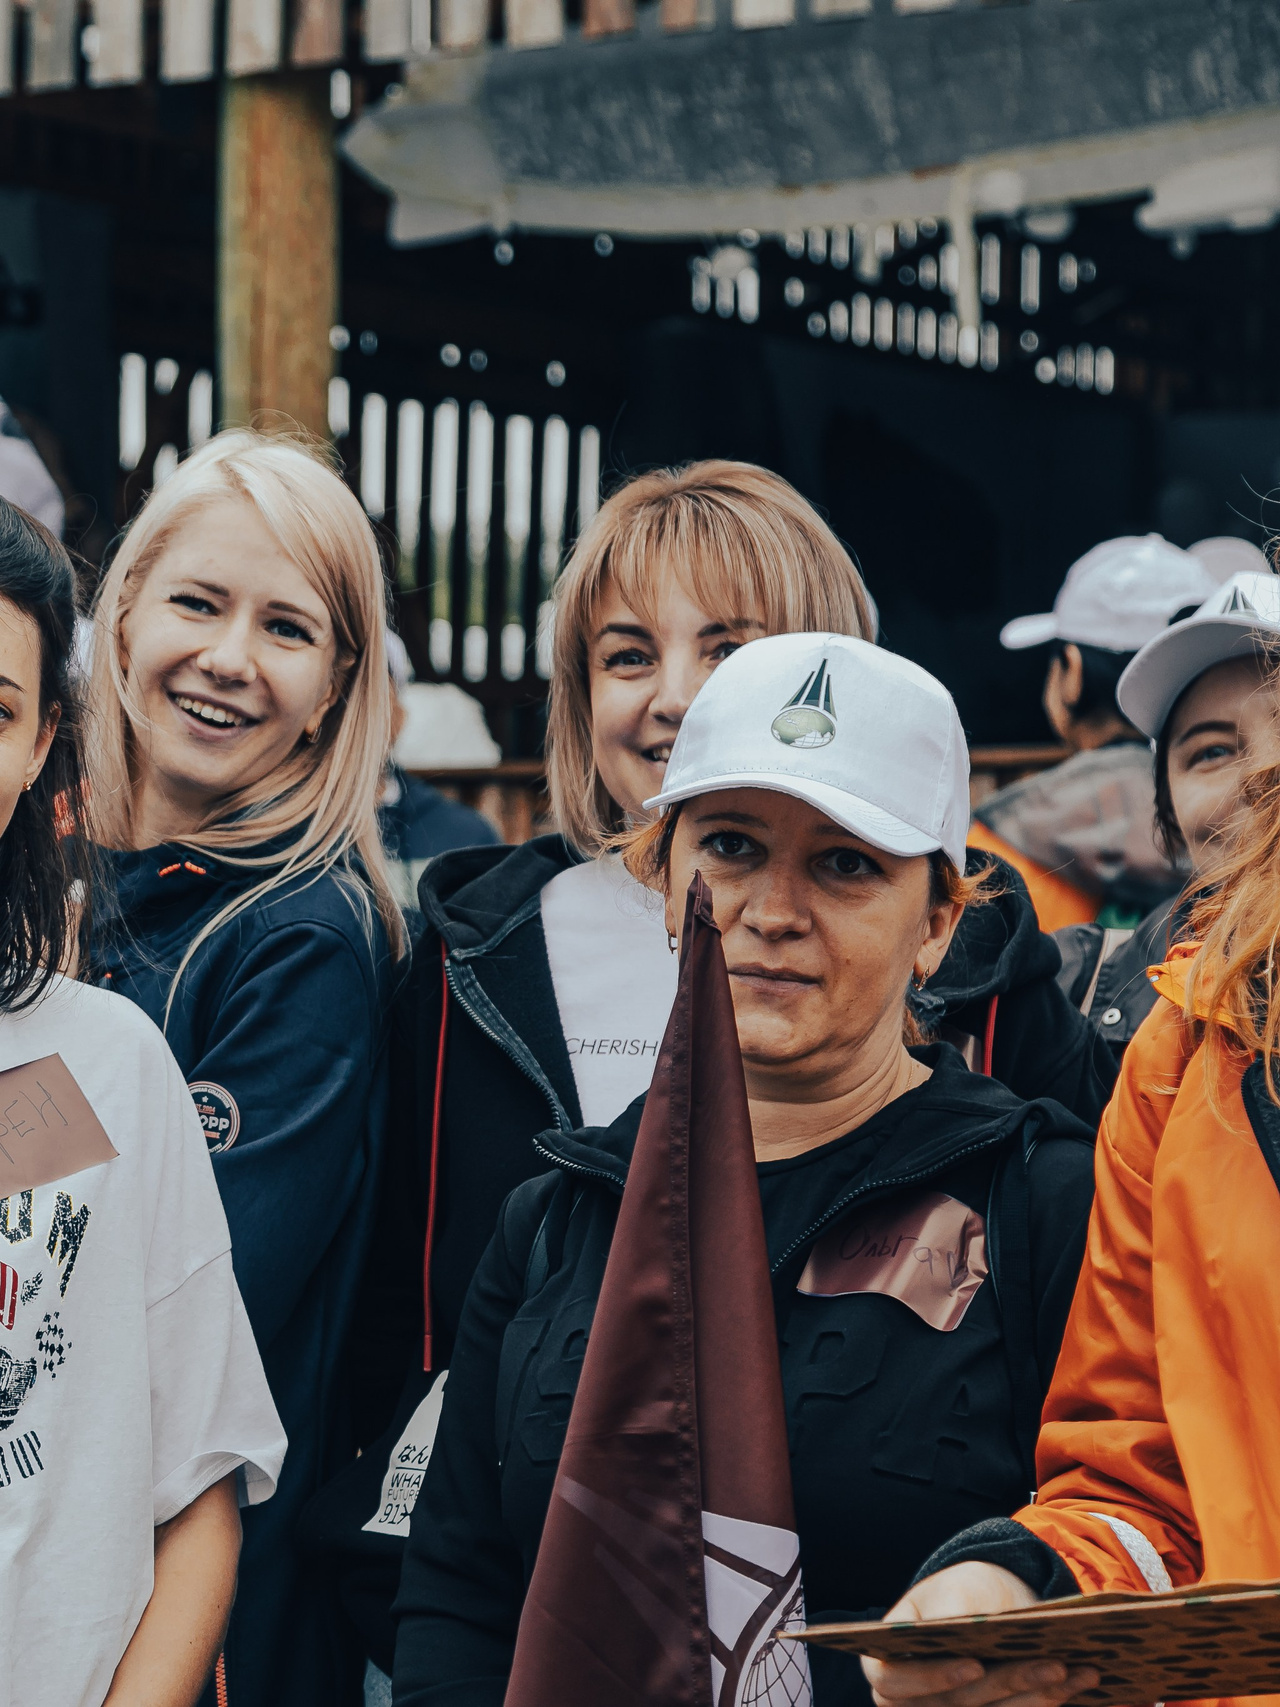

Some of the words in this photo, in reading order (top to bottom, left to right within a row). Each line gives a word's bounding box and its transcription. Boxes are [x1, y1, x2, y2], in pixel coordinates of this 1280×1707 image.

[566, 1037, 660, 1057] CHERISH
[199, 1114, 230, 1131] OPP
[7, 1429, 46, 1480] UP
[390, 1472, 421, 1489] WHA
